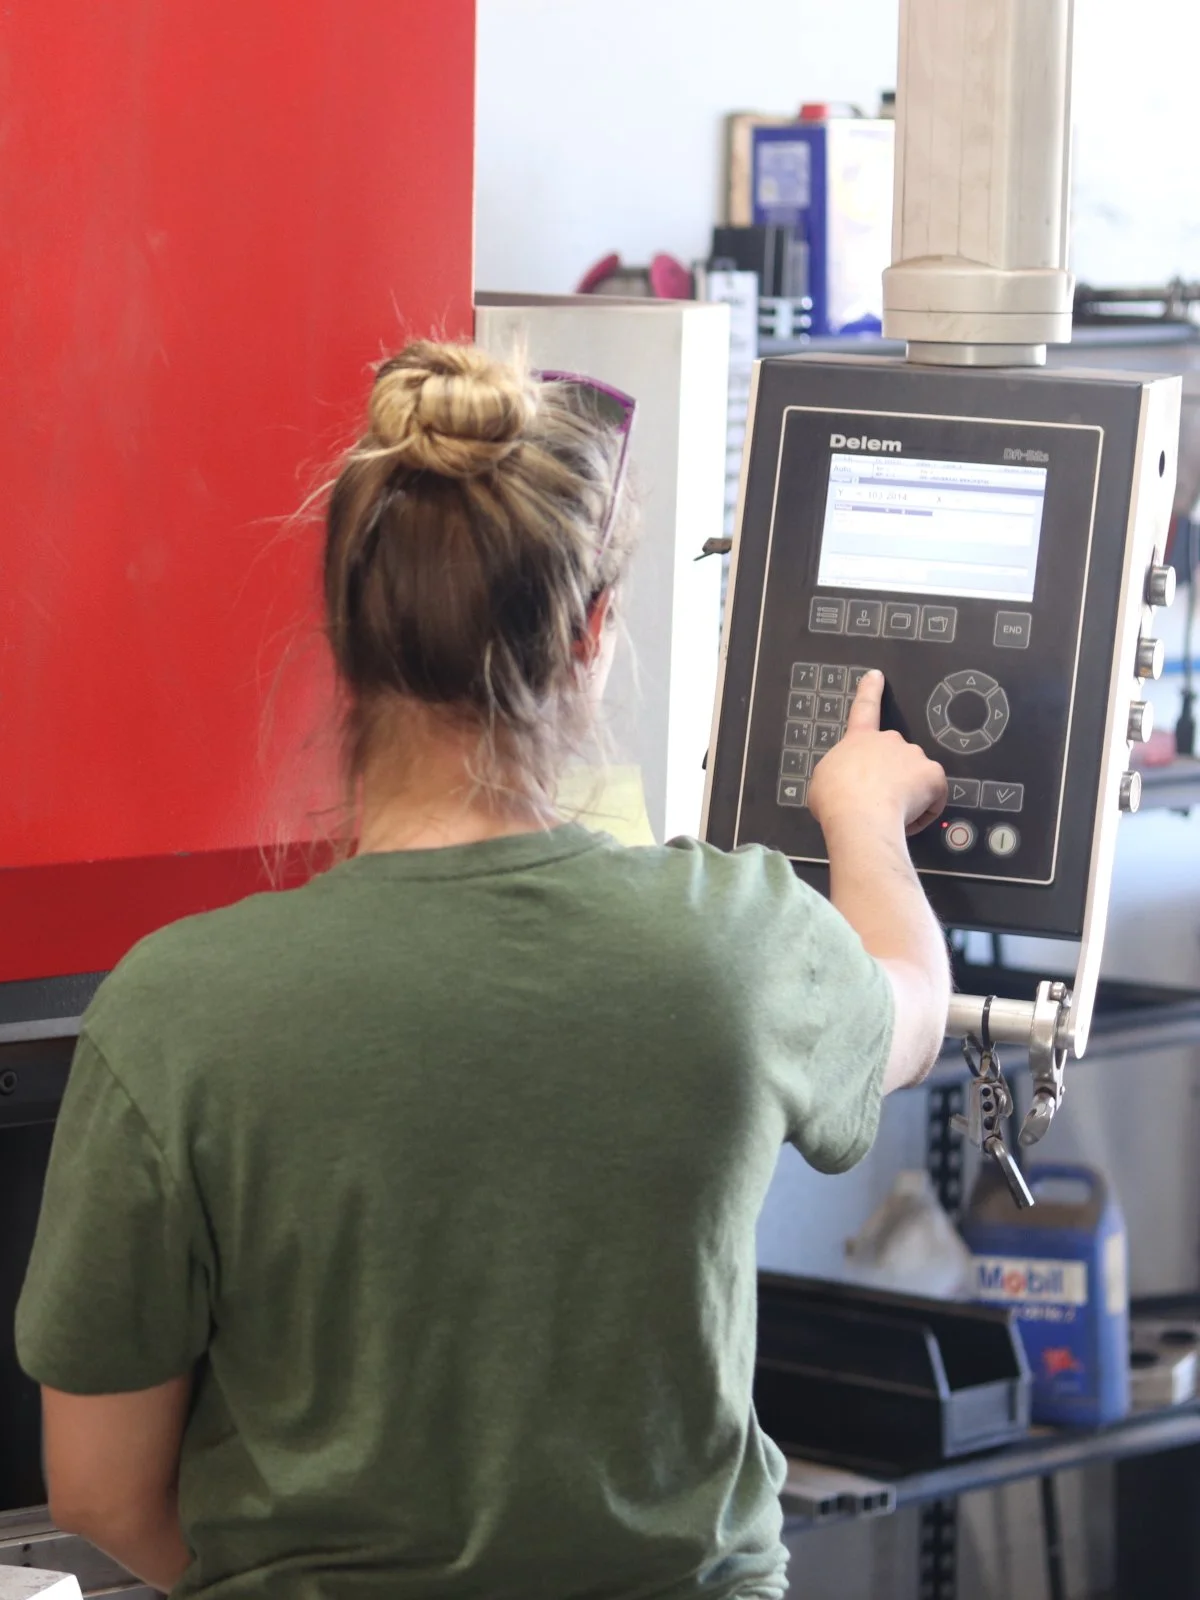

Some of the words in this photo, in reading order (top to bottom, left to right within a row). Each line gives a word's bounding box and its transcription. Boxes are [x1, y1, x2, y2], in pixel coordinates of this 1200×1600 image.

[829, 433, 902, 452] Delem
[1003, 625, 1022, 634] END
[800, 671, 806, 681] 7
[827, 674, 834, 684] 8
[796, 700, 802, 710] 4
[824, 702, 831, 713] 5
[794, 730, 798, 739] 1
[821, 731, 827, 741] 2
[978, 1263, 1063, 1294] Mobil
